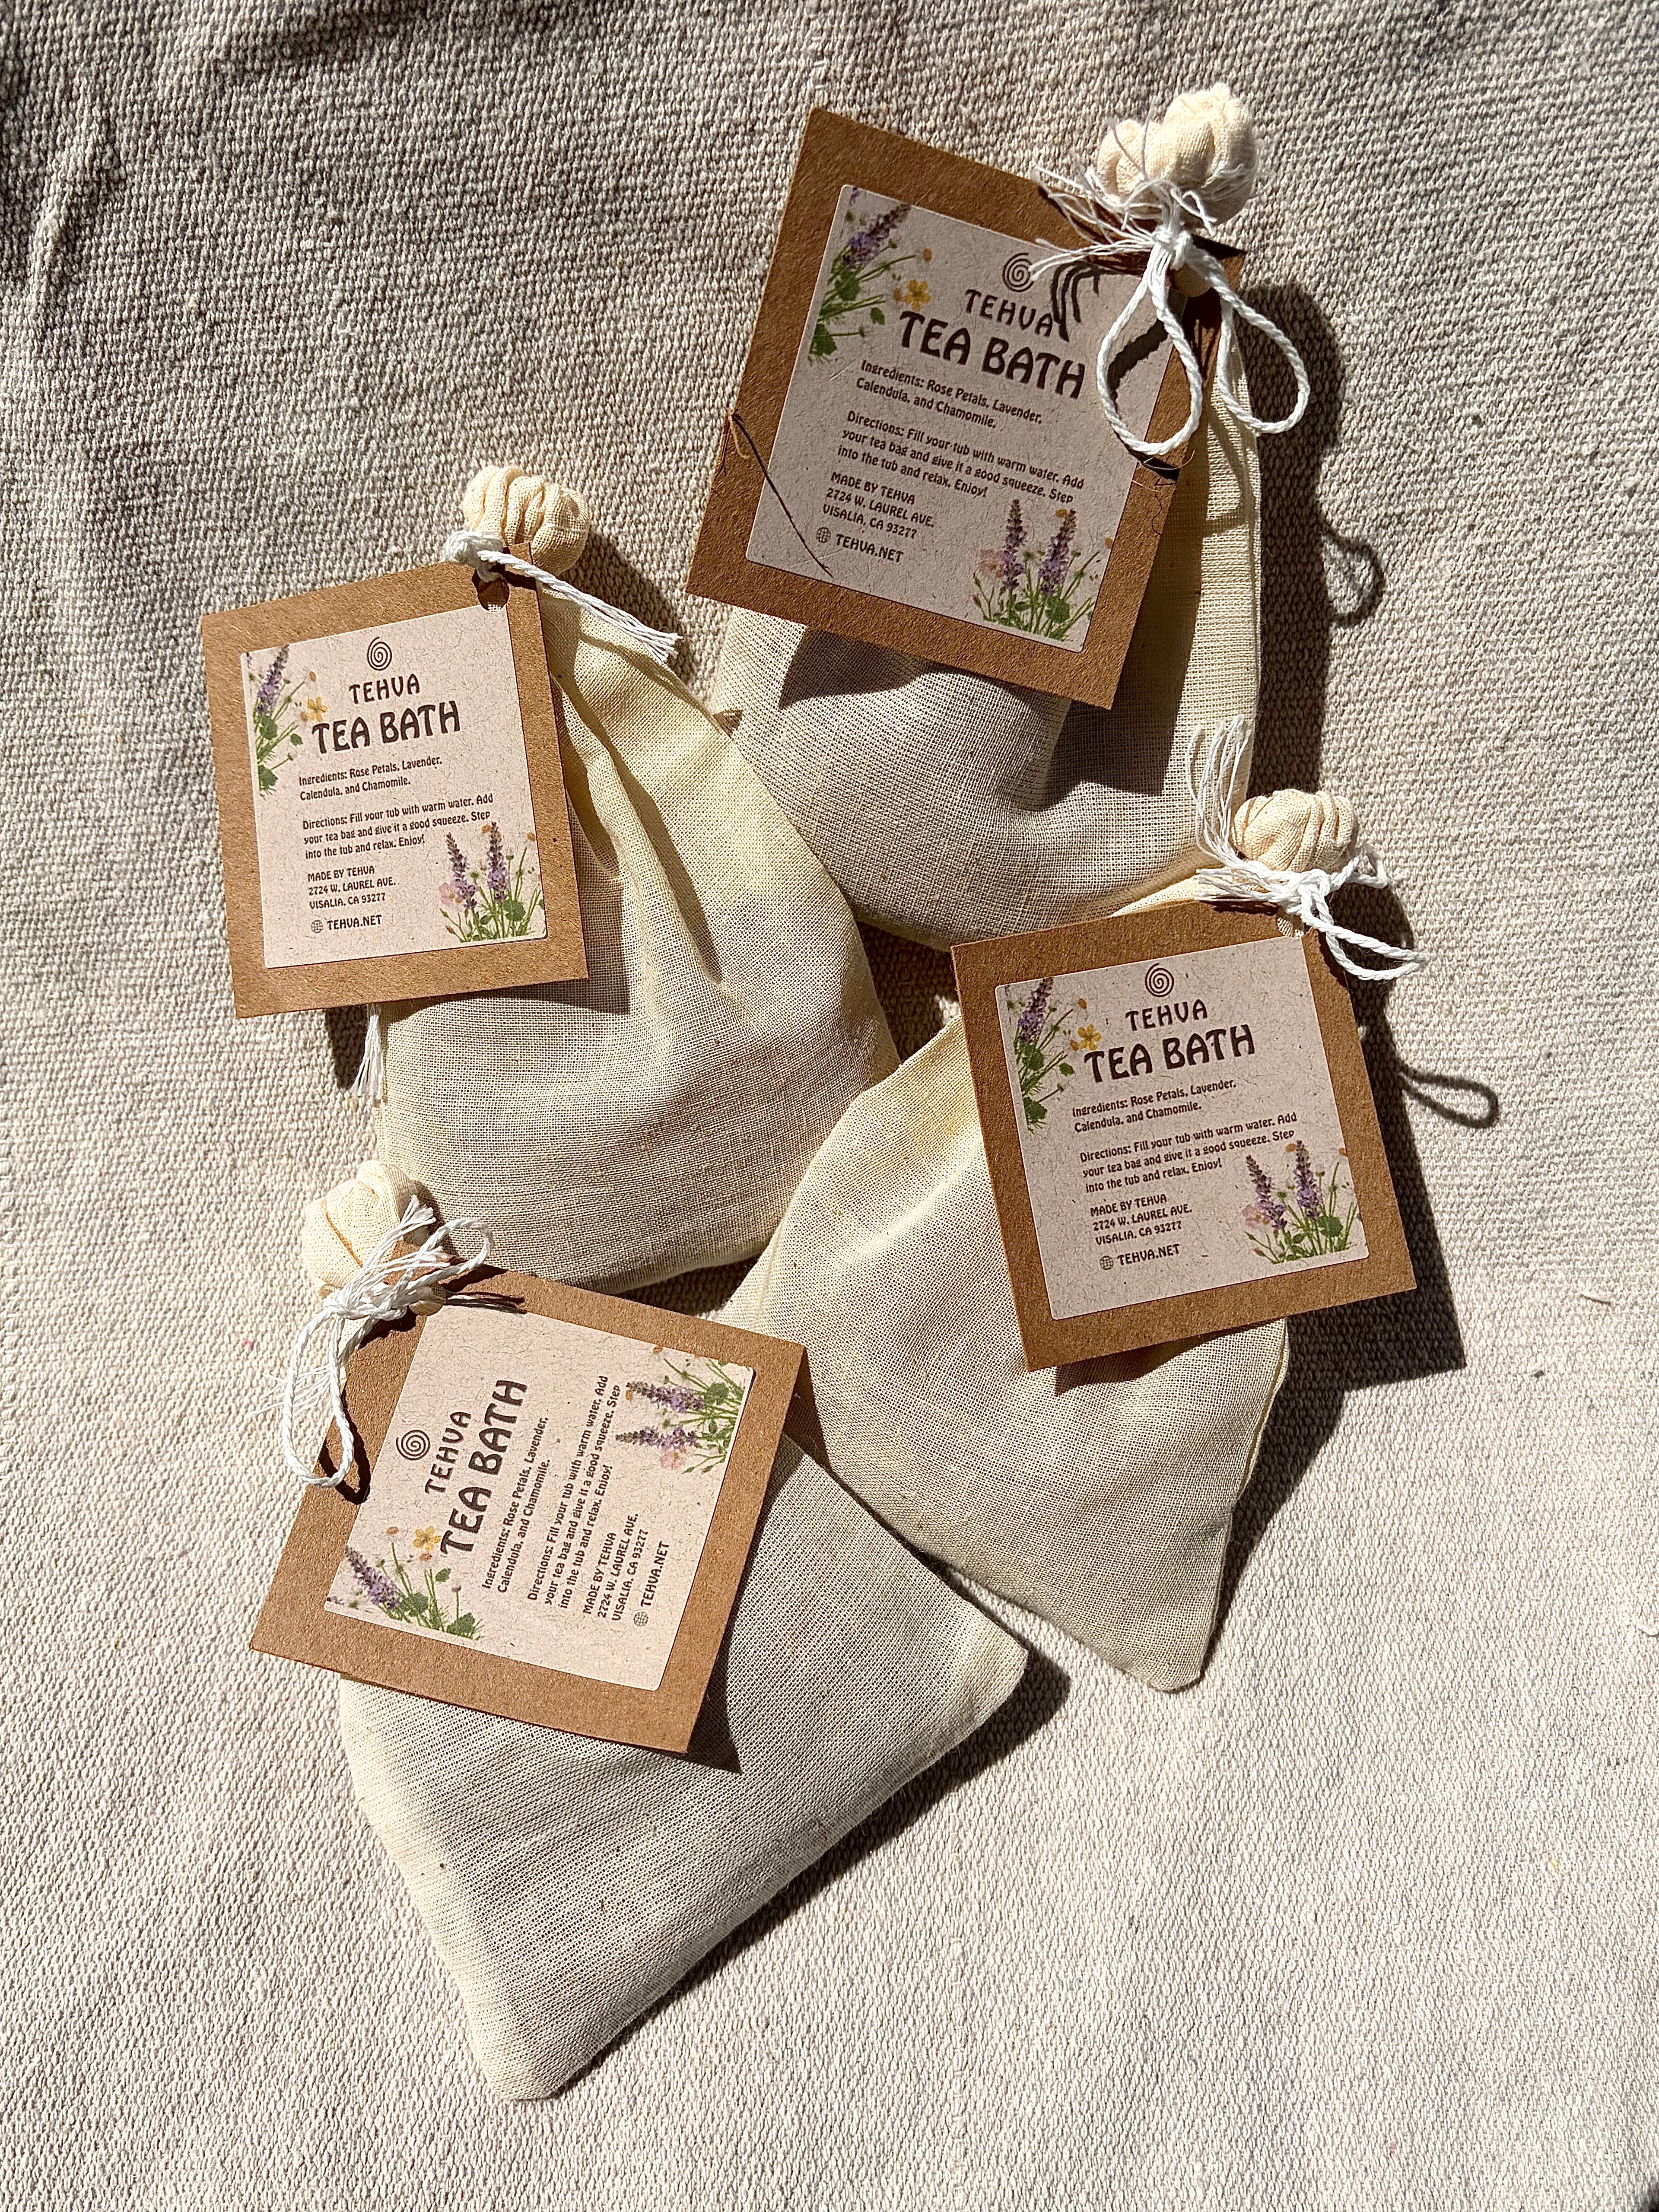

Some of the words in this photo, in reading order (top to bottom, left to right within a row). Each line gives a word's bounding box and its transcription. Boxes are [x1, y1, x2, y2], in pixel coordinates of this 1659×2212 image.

[965, 289, 1053, 337] TEHVA
[899, 310, 971, 365] TEA
[981, 337, 1085, 400] BATH
[861, 359, 925, 388] Ingredients:
[926, 378, 953, 397] Rose
[913, 396, 934, 410] and
[935, 400, 996, 429] Chamomile.
[846, 410, 905, 437] Directions:
[906, 427, 925, 443] Fill
[925, 435, 951, 450] your
[952, 442, 970, 456] tub
[972, 449, 995, 464] with
[997, 456, 1027, 473] warm
[1029, 465, 1059, 483] water.
[1062, 474, 1085, 490] Add
[837, 444, 859, 461] into
[861, 451, 879, 467] the
[880, 458, 899, 472] tub
[899, 464, 922, 479] and
[922, 471, 951, 488] relax.
[953, 478, 988, 498] Enjoy!
[841, 429, 868, 445] your
[869, 435, 887, 451] tea
[888, 441, 909, 457] bag
[909, 449, 931, 463] and
[931, 454, 953, 470] give
[954, 460, 964, 473] it
[964, 465, 973, 475] a
[973, 468, 1001, 484] good
[1001, 477, 1046, 498] squeeze.
[1048, 487, 1074, 504] Step
[830, 471, 862, 490] MADE
[863, 480, 879, 494] BY
[880, 485, 915, 505] TEHVA
[826, 487, 852, 504] 2724
[854, 495, 866, 509] W.
[868, 499, 908, 520] LAUREL
[910, 512, 934, 528] AVE.
[869, 517, 884, 531] CA
[886, 522, 918, 539] 93277
[836, 533, 904, 563] TEHVA.NET
[348, 673, 420, 705] TEHVA
[311, 716, 371, 754] TEA
[379, 700, 461, 744] BATH
[298, 771, 348, 786] Ingredients:
[349, 768, 370, 779] Rose
[344, 782, 360, 795] and
[362, 775, 411, 792] Chamomile.
[302, 816, 348, 830] Directions:
[349, 812, 363, 823] Fill
[364, 811, 384, 821] your
[385, 807, 400, 818] tub
[401, 804, 420, 816] with
[421, 802, 446, 813] warm
[448, 798, 475, 809] water.
[476, 793, 494, 805] Add
[305, 849, 322, 860] into
[323, 847, 337, 857] the
[339, 844, 353, 855] tub
[355, 841, 371, 853] and
[372, 839, 397, 851] relax.
[398, 833, 426, 847] Enjoy!
[307, 870, 332, 883] MADE
[333, 868, 345, 879] BY
[346, 865, 375, 877] TEHVA
[308, 885, 329, 896] 2724
[330, 884, 341, 893] W.
[342, 879, 375, 892] LAUREL
[376, 876, 396, 888] AVE.
[347, 896, 360, 906] CA
[361, 892, 386, 904] 93277
[326, 914, 382, 931] TEHVA.NET
[1125, 998, 1208, 1032] TEHVA
[1084, 1043, 1153, 1084] TEA
[1162, 1023, 1255, 1070] BATH
[1071, 1099, 1128, 1118] Ingredients:
[1130, 1094, 1154, 1108] Rose
[1125, 1110, 1144, 1124] and
[1145, 1101, 1202, 1120] Chamomile.
[1079, 1145, 1132, 1163] Directions:
[1133, 1140, 1150, 1153] Fill
[1150, 1137, 1173, 1150] your
[1174, 1132, 1191, 1144] tub
[1192, 1128, 1214, 1141] with
[1215, 1124, 1243, 1136] warm
[1245, 1118, 1276, 1130] water.
[1277, 1112, 1297, 1125] Add
[1085, 1182, 1105, 1194] into
[1106, 1178, 1123, 1189] the
[1124, 1173, 1141, 1186] tub
[1142, 1169, 1161, 1182] and
[1162, 1166, 1190, 1179] relax.
[1191, 1157, 1223, 1173] Enjoy!
[1090, 1202, 1119, 1217] MADE
[1119, 1199, 1132, 1211] BY
[1134, 1193, 1167, 1208] TEHVA
[1092, 1218, 1116, 1232] 2724
[1117, 1216, 1130, 1227] W.
[1130, 1208, 1169, 1224] LAUREL
[1170, 1203, 1193, 1216] AVE.
[1138, 1226, 1153, 1237] CA
[1154, 1220, 1182, 1234] 93277
[1116, 1243, 1180, 1266] TEHVA.NET
[424, 1411, 472, 1494] TEHVA
[439, 1486, 493, 1555] TEA
[467, 1379, 528, 1475] BATH
[522, 1459, 550, 1517] Chamomile.
[527, 1545, 554, 1601] Directions:
[546, 1526, 560, 1544] Fill
[553, 1501, 568, 1526] your
[561, 1482, 574, 1499] tub
[568, 1459, 582, 1481] with
[576, 1430, 592, 1457] warm
[585, 1398, 602, 1427] water.
[594, 1375, 609, 1397] Add
[594, 1464, 613, 1497] Enjoy!
[517, 1518, 531, 1538] and
[586, 1499, 603, 1528] relax.
[481, 1528, 511, 1589] Ingredients:
[502, 1501, 520, 1527] Rose
[579, 1528, 593, 1549] and
[597, 1532, 617, 1566] TEHVA
[631, 1529, 648, 1559] 93277
[572, 1550, 585, 1567] tub
[610, 1538, 631, 1577] LAUREL
[626, 1561, 639, 1576] CA
[566, 1569, 580, 1586] the
[592, 1567, 605, 1583] BY
[605, 1579, 618, 1591] W.
[640, 1540, 670, 1607] TEHVA.NET
[559, 1588, 573, 1609] into
[582, 1584, 601, 1615] MADE
[597, 1593, 613, 1618] 2724
